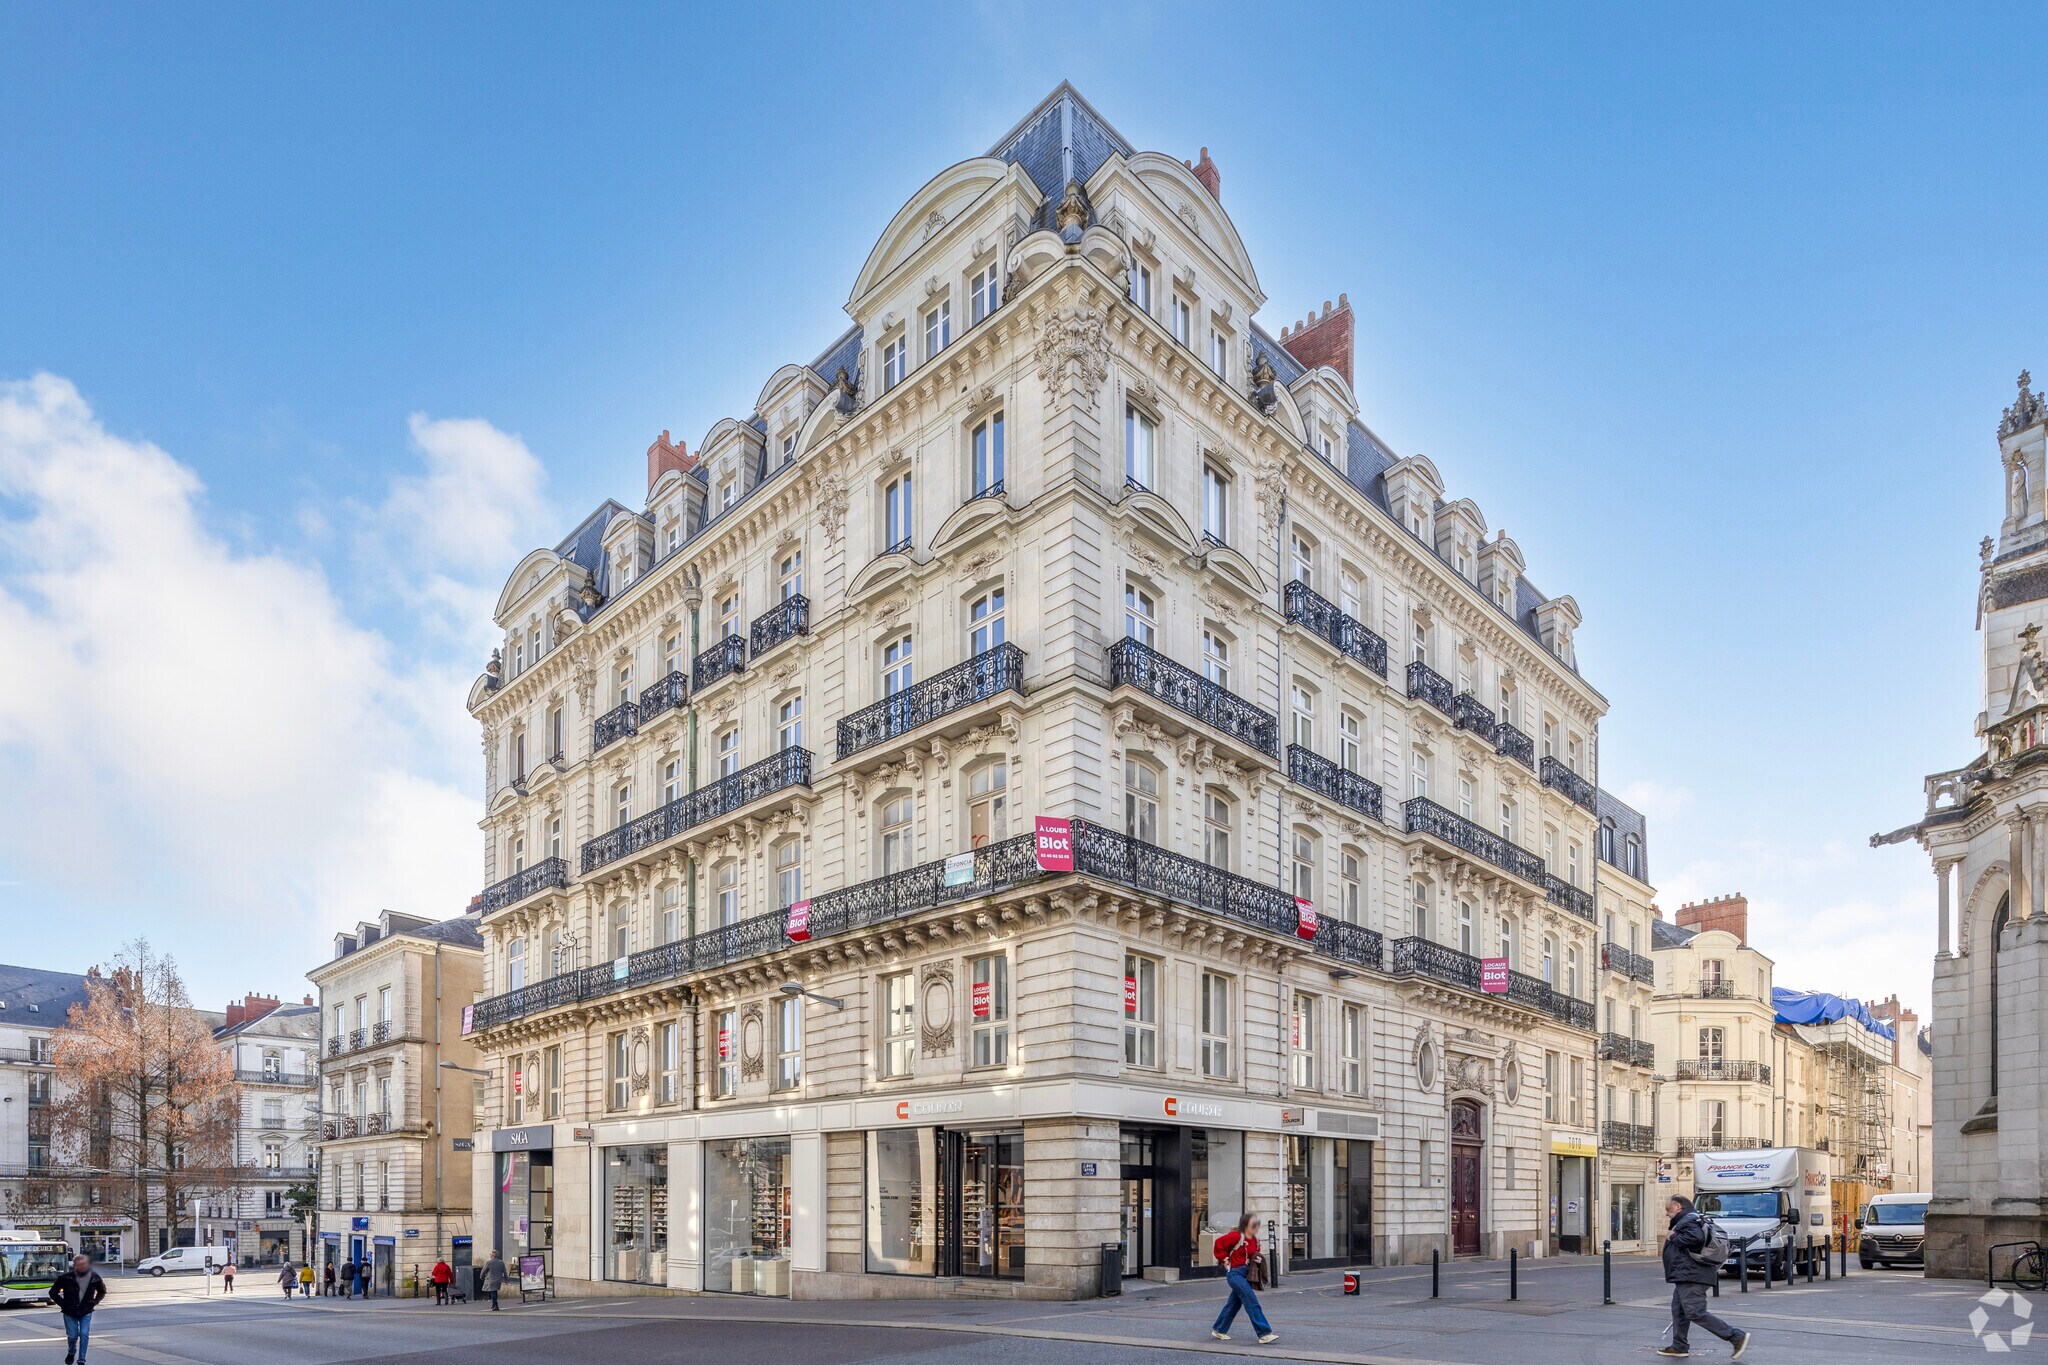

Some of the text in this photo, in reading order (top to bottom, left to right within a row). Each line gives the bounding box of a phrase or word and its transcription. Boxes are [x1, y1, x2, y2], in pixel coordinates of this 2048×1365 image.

[1039, 824, 1045, 832] À
[1039, 836, 1069, 851] Blot
[790, 916, 806, 928] Blot
[1302, 912, 1316, 925] Blot
[1484, 972, 1506, 980] Blot
[974, 995, 989, 1005] Blot
[511, 1130, 528, 1145] SAGA
[1568, 1137, 1581, 1149] TOTO
